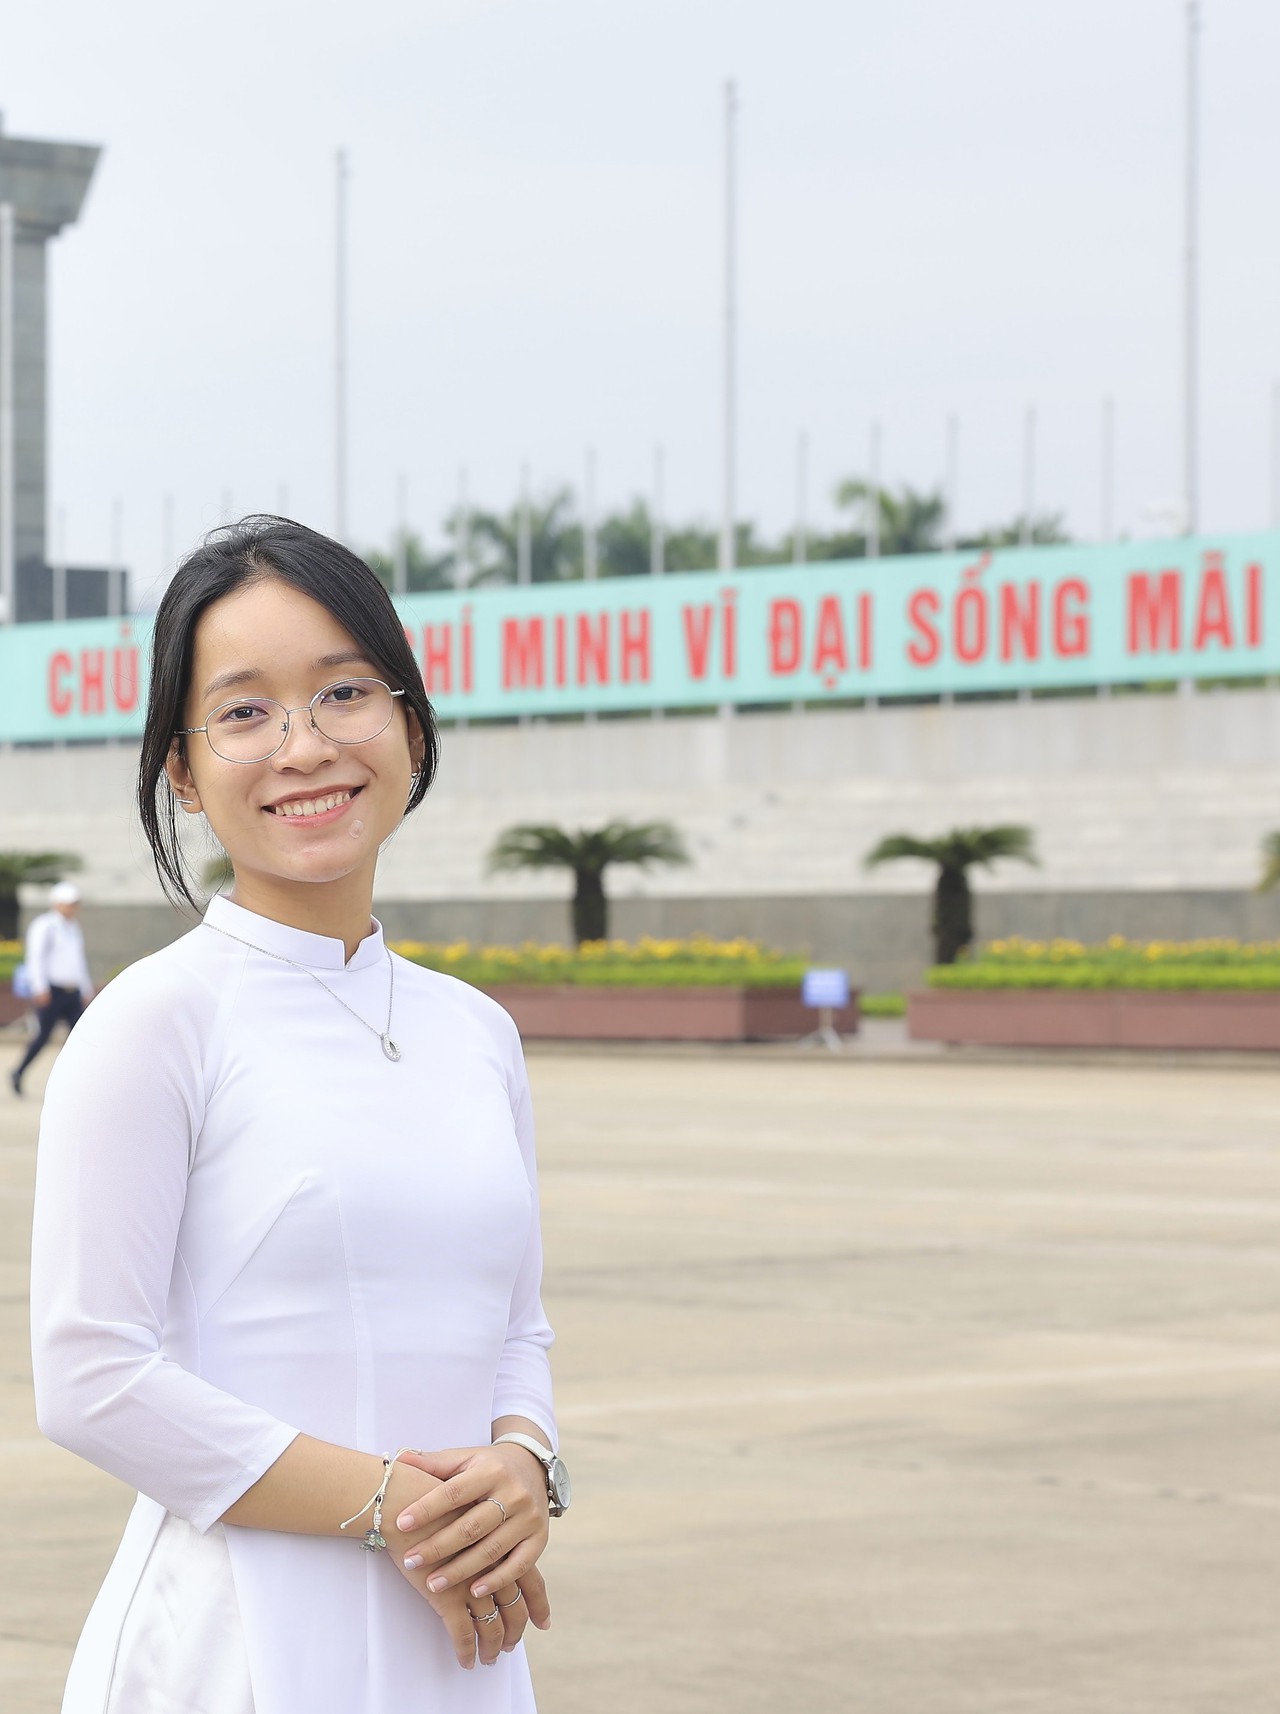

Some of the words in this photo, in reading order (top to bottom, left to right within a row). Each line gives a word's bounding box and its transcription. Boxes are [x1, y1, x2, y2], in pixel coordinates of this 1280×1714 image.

[48, 621, 140, 716] CHỦ
[404, 604, 474, 695] HÍ
[500, 608, 653, 691] MINH
[683, 588, 738, 680] VĨ
[768, 592, 873, 690] ĐẠI
[906, 552, 1091, 668] SỐNG
[1126, 549, 1263, 655] MÃI
